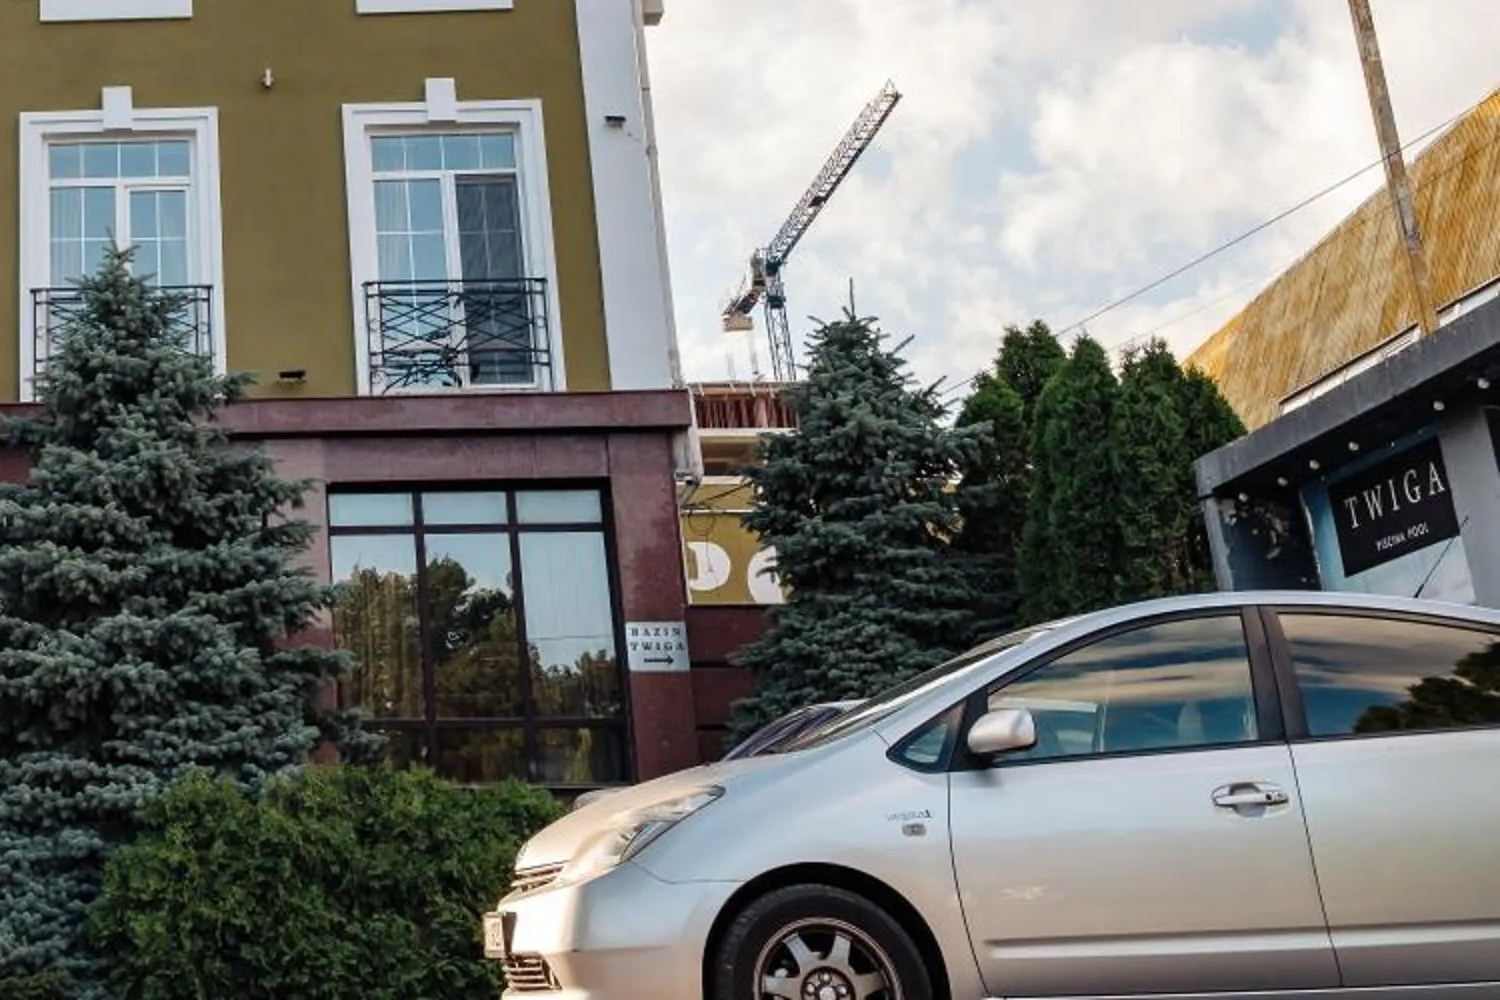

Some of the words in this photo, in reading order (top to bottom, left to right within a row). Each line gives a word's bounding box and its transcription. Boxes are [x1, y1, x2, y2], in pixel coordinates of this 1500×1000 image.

[1343, 461, 1445, 529] TWIGA
[1407, 521, 1429, 539] POOL
[630, 641, 684, 651] TWIGA
